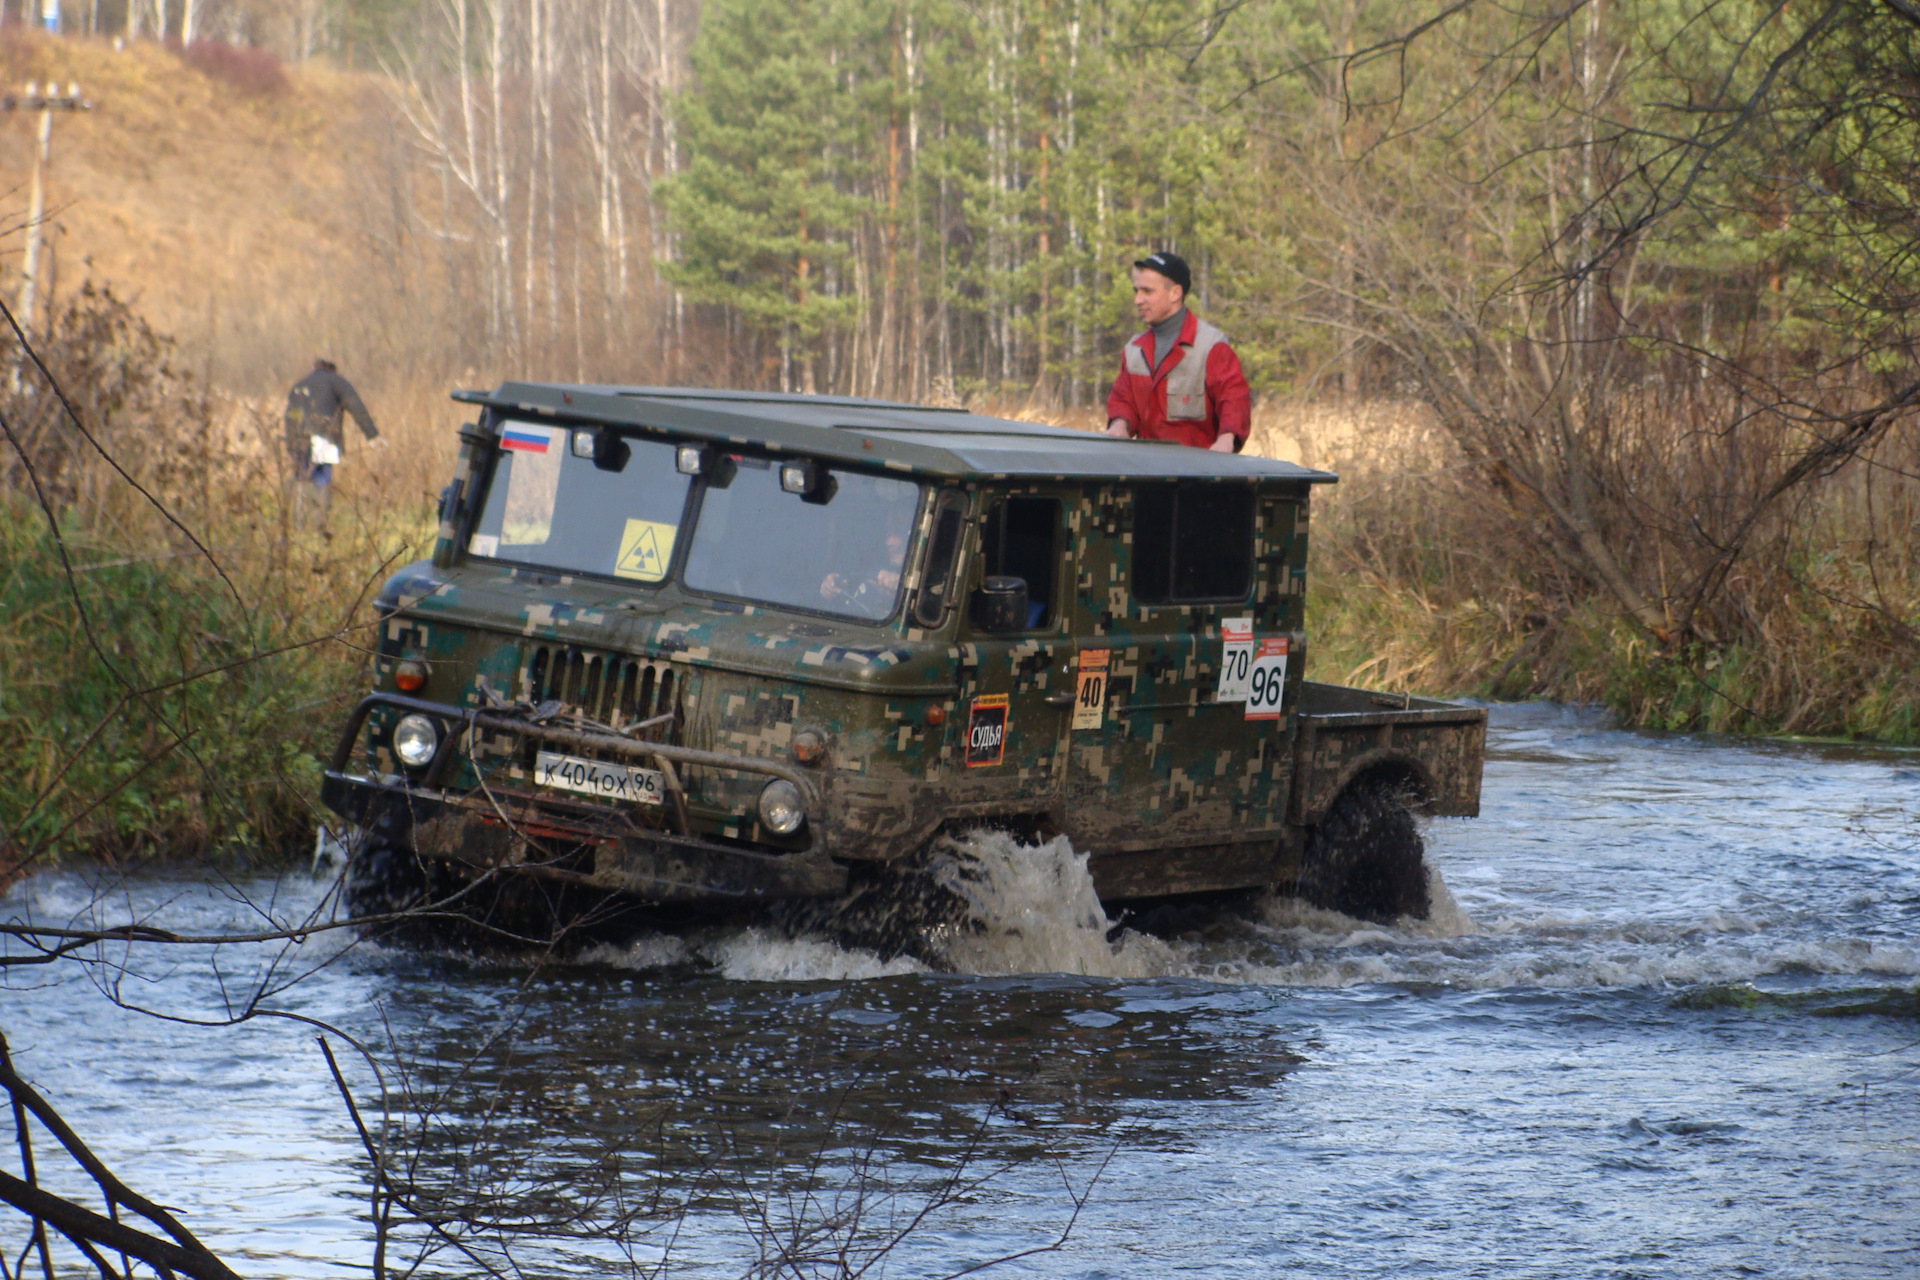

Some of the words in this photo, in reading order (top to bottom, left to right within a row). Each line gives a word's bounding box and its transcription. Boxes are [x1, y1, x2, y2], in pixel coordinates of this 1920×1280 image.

[1227, 650, 1249, 682] 70
[1080, 676, 1102, 708] 40
[1250, 666, 1282, 707] 96
[970, 724, 1003, 751] СУДЬЯ
[634, 773, 655, 792] 96
